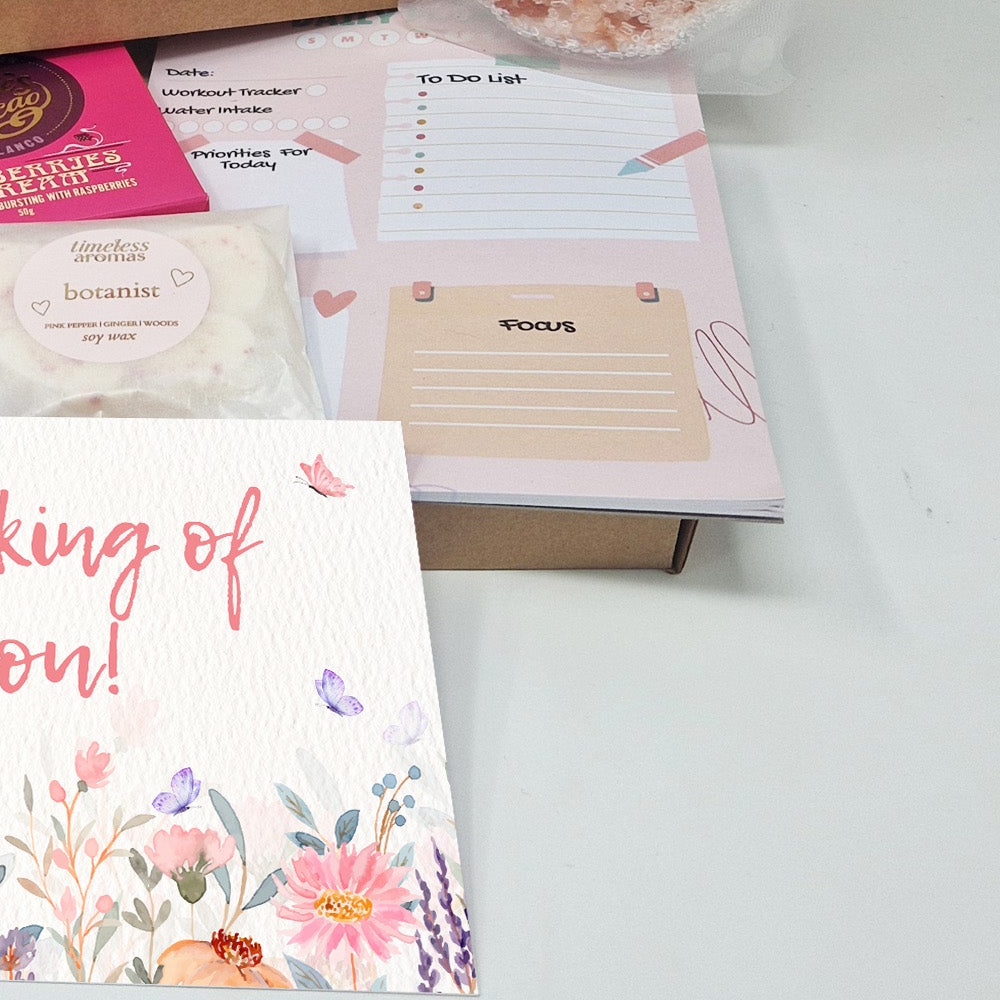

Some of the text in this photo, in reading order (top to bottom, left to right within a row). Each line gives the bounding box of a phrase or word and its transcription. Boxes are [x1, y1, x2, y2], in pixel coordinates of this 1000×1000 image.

[165, 68, 214, 77] Date:
[416, 73, 528, 84] To Do List
[161, 87, 302, 97] Workout Tracker
[158, 105, 273, 115] Water Intake
[191, 148, 313, 160] Priorities For
[220, 160, 276, 171] Today
[46, 190, 72, 202] WITH
[73, 177, 139, 198] RASPBERRIES
[18, 207, 36, 217] 50g
[70, 239, 150, 253] timeless
[74, 252, 146, 262] aromas
[63, 282, 160, 300] botanist
[67, 321, 98, 329] PEPPER
[103, 320, 138, 328] GINGER
[499, 318, 577, 334] Focus
[81, 332, 138, 345] soy wax
[183, 486, 264, 631] of
